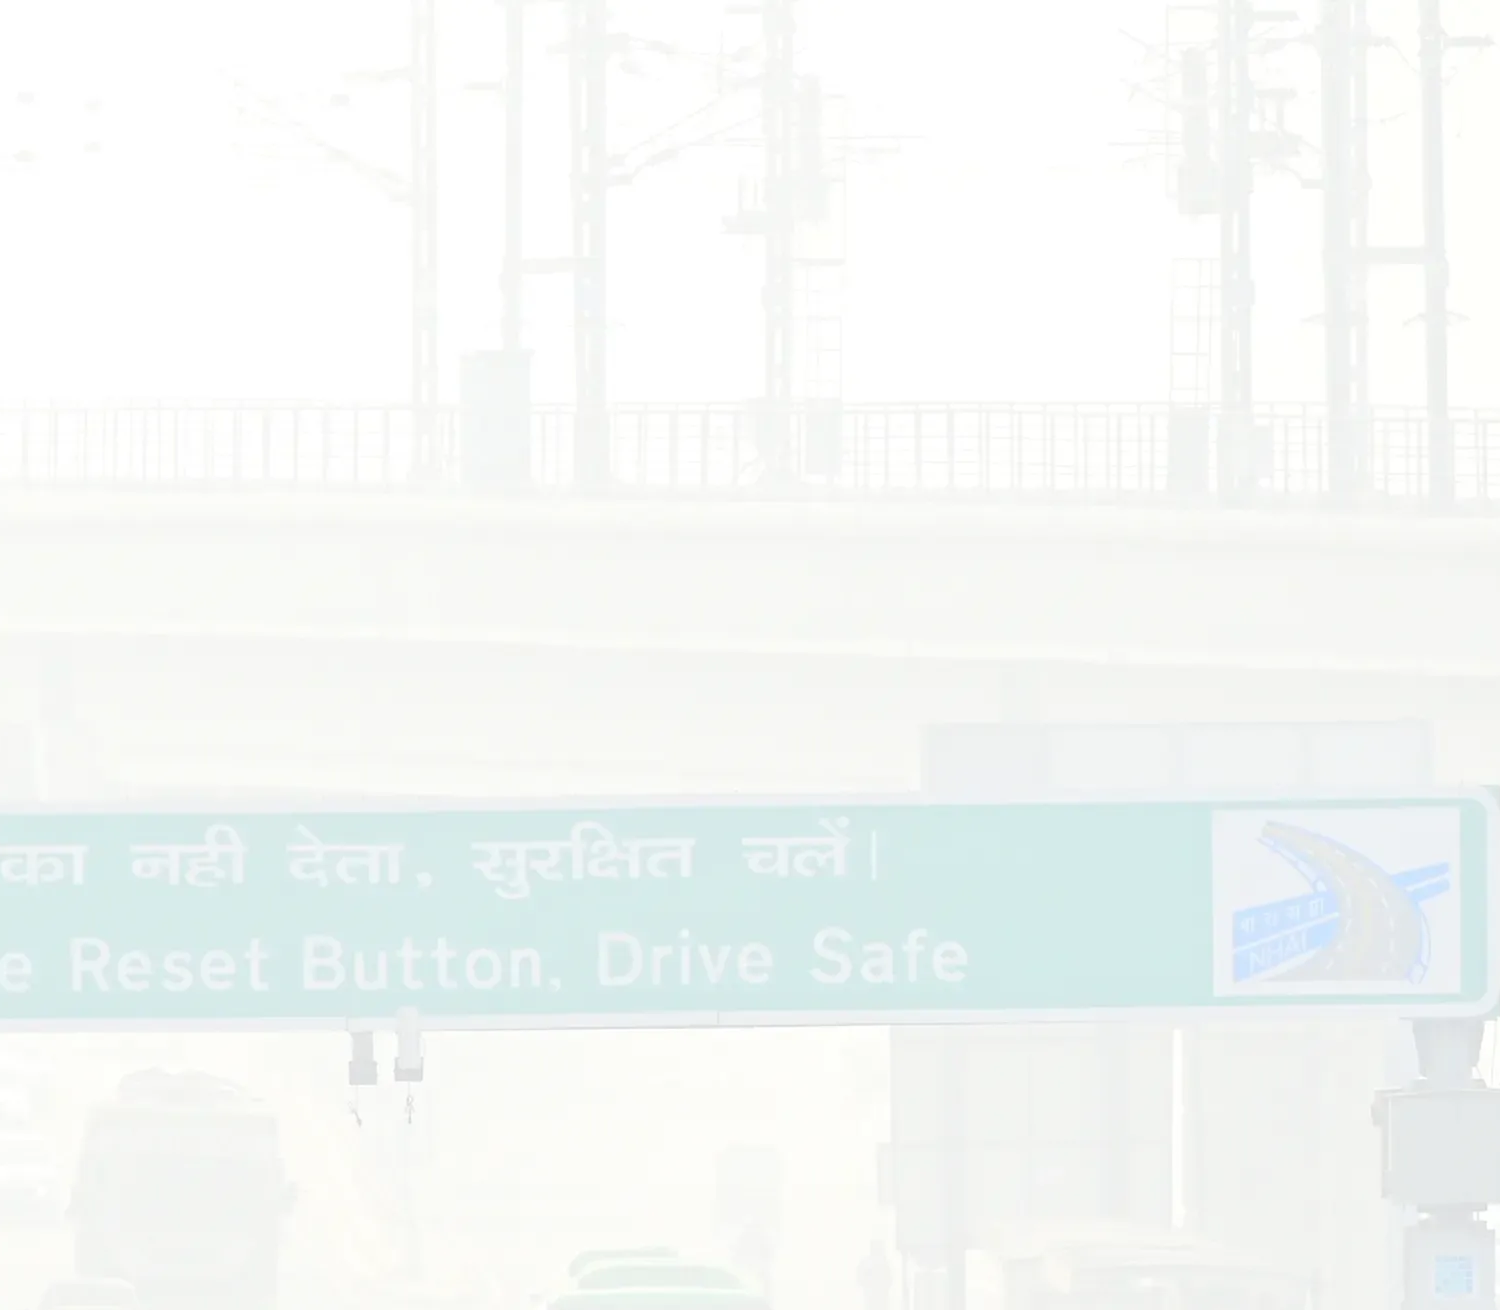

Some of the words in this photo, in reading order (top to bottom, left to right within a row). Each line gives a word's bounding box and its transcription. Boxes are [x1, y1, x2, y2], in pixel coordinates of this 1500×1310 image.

[286, 825, 433, 888] देता,
[471, 820, 697, 899] सुरक्षित
[68, 936, 267, 993] Reset
[596, 929, 775, 989] Drive
[809, 926, 969, 987] Safe
